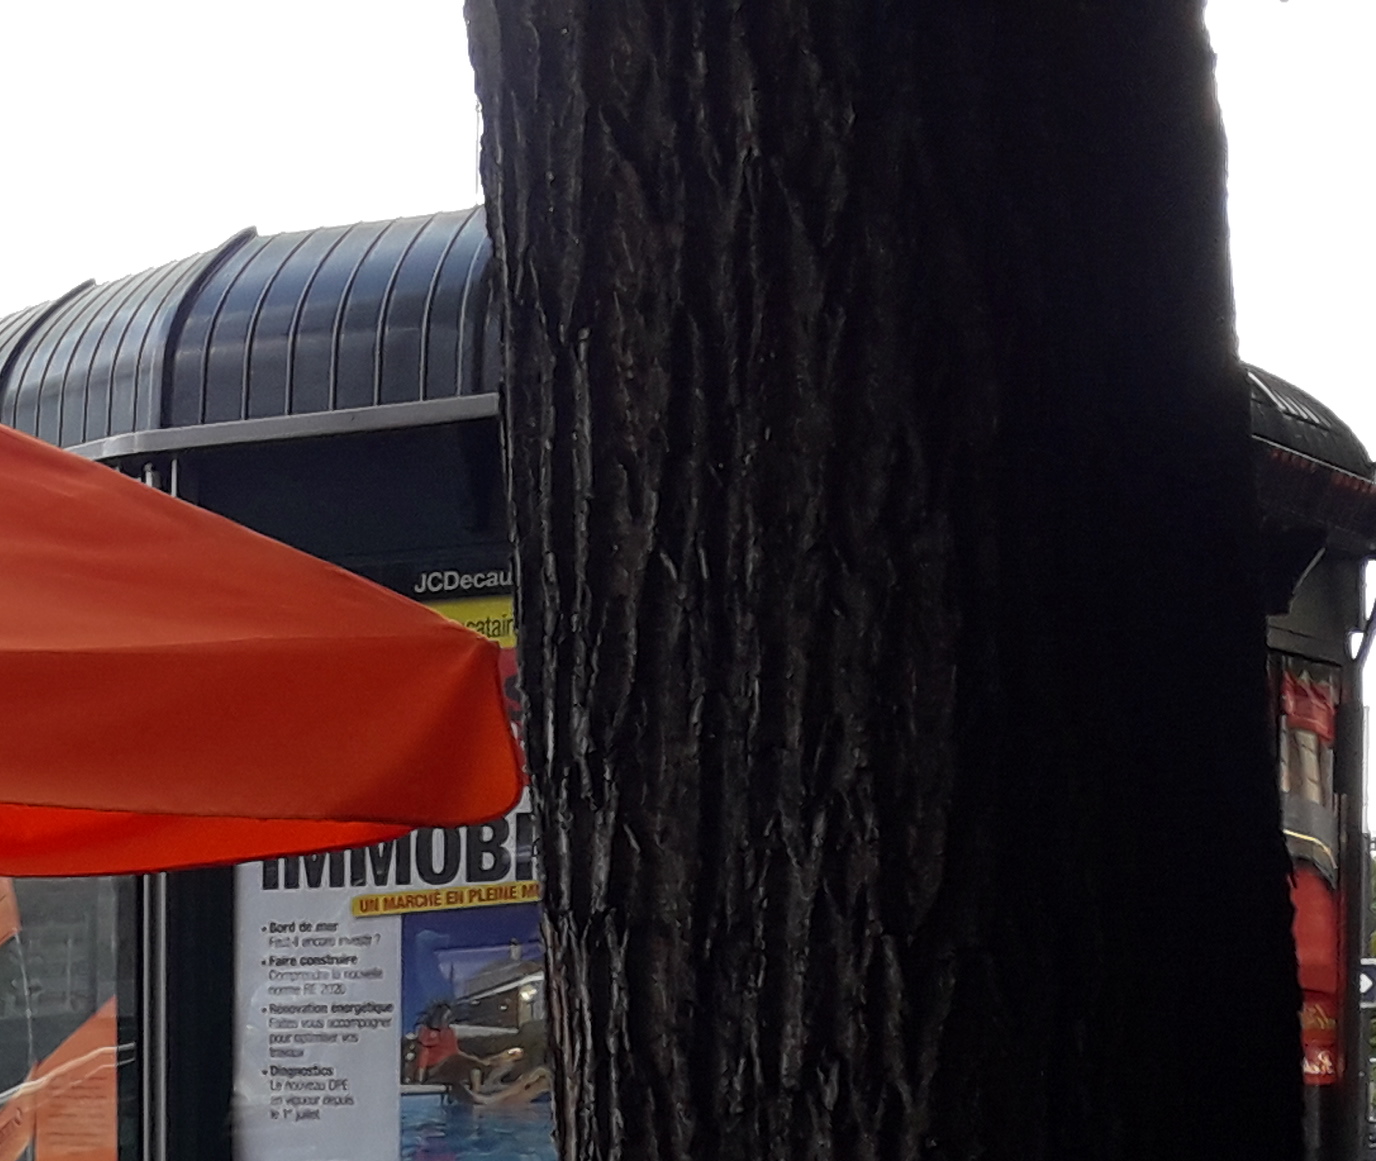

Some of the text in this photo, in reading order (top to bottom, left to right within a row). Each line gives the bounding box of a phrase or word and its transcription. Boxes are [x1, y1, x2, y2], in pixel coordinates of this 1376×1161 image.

[414, 571, 513, 593] JCDecau
[360, 899, 379, 912] UN
[447, 891, 465, 905] EN
[469, 886, 517, 904] PLEINE
